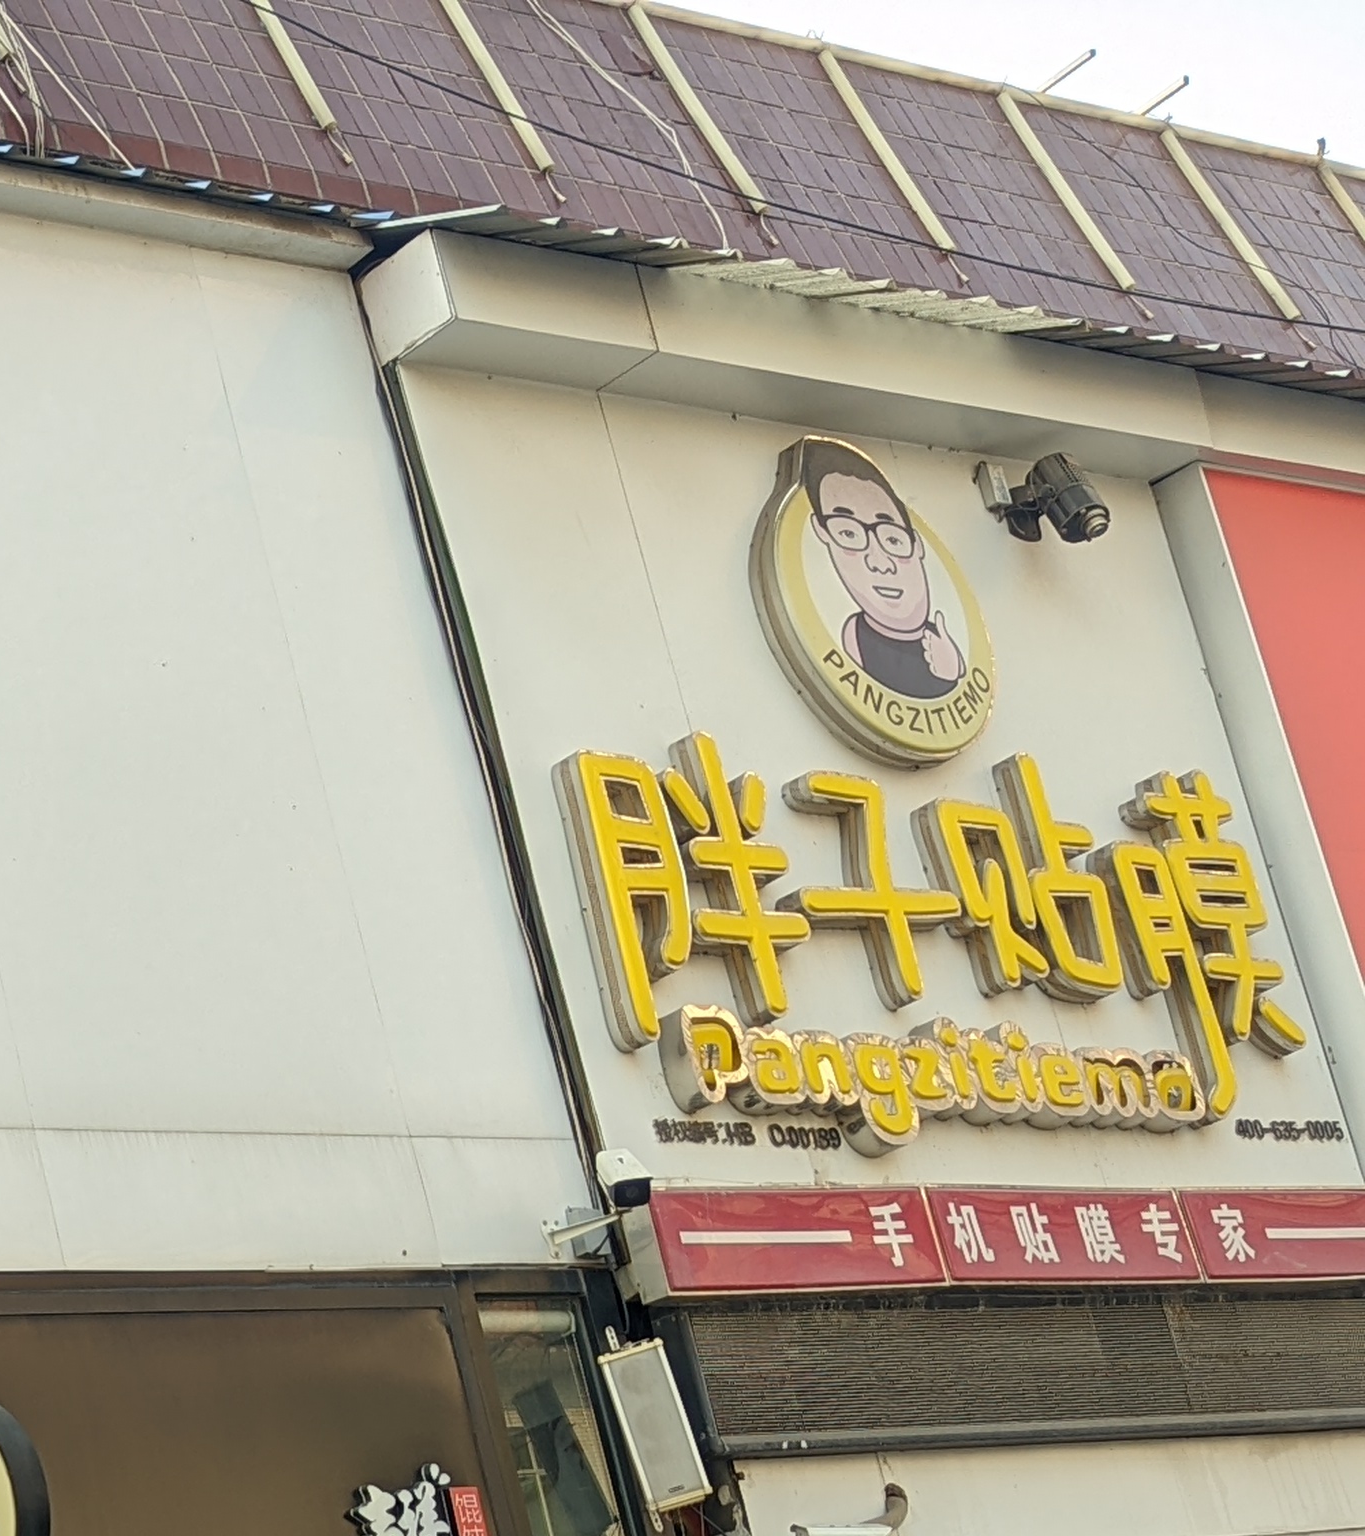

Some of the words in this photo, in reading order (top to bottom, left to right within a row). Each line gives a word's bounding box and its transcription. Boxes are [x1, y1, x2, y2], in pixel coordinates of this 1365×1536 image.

[822, 646, 992, 737] PANGZITIEMO
[554, 731, 1309, 1117] 胖子贴膜
[682, 1006, 1209, 1146] Pangzitiemo
[869, 1199, 1258, 1270] 手机贴膜专家
